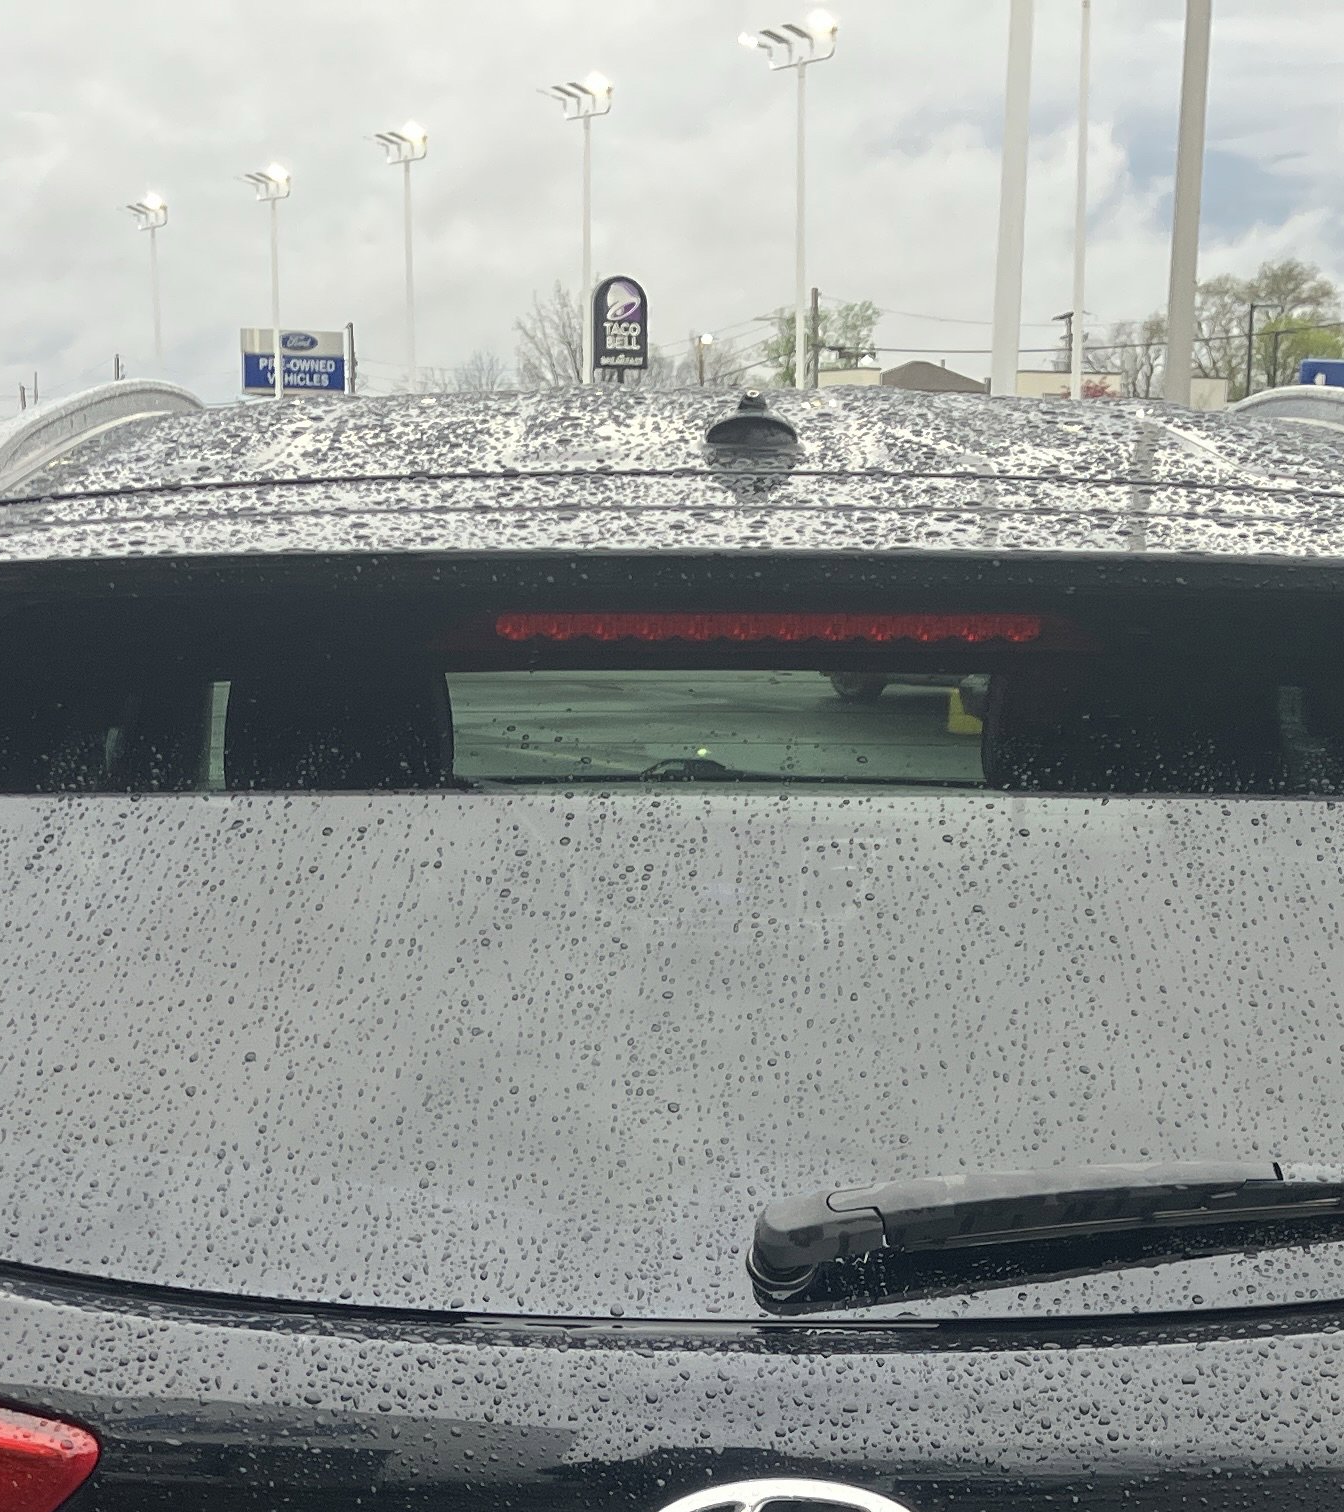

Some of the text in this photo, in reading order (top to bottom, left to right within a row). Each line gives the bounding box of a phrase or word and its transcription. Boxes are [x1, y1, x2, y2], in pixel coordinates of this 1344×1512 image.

[603, 322, 641, 336] TACO
[286, 335, 312, 347] Ford
[606, 335, 641, 350] BELL
[267, 371, 329, 386] VHICLES
